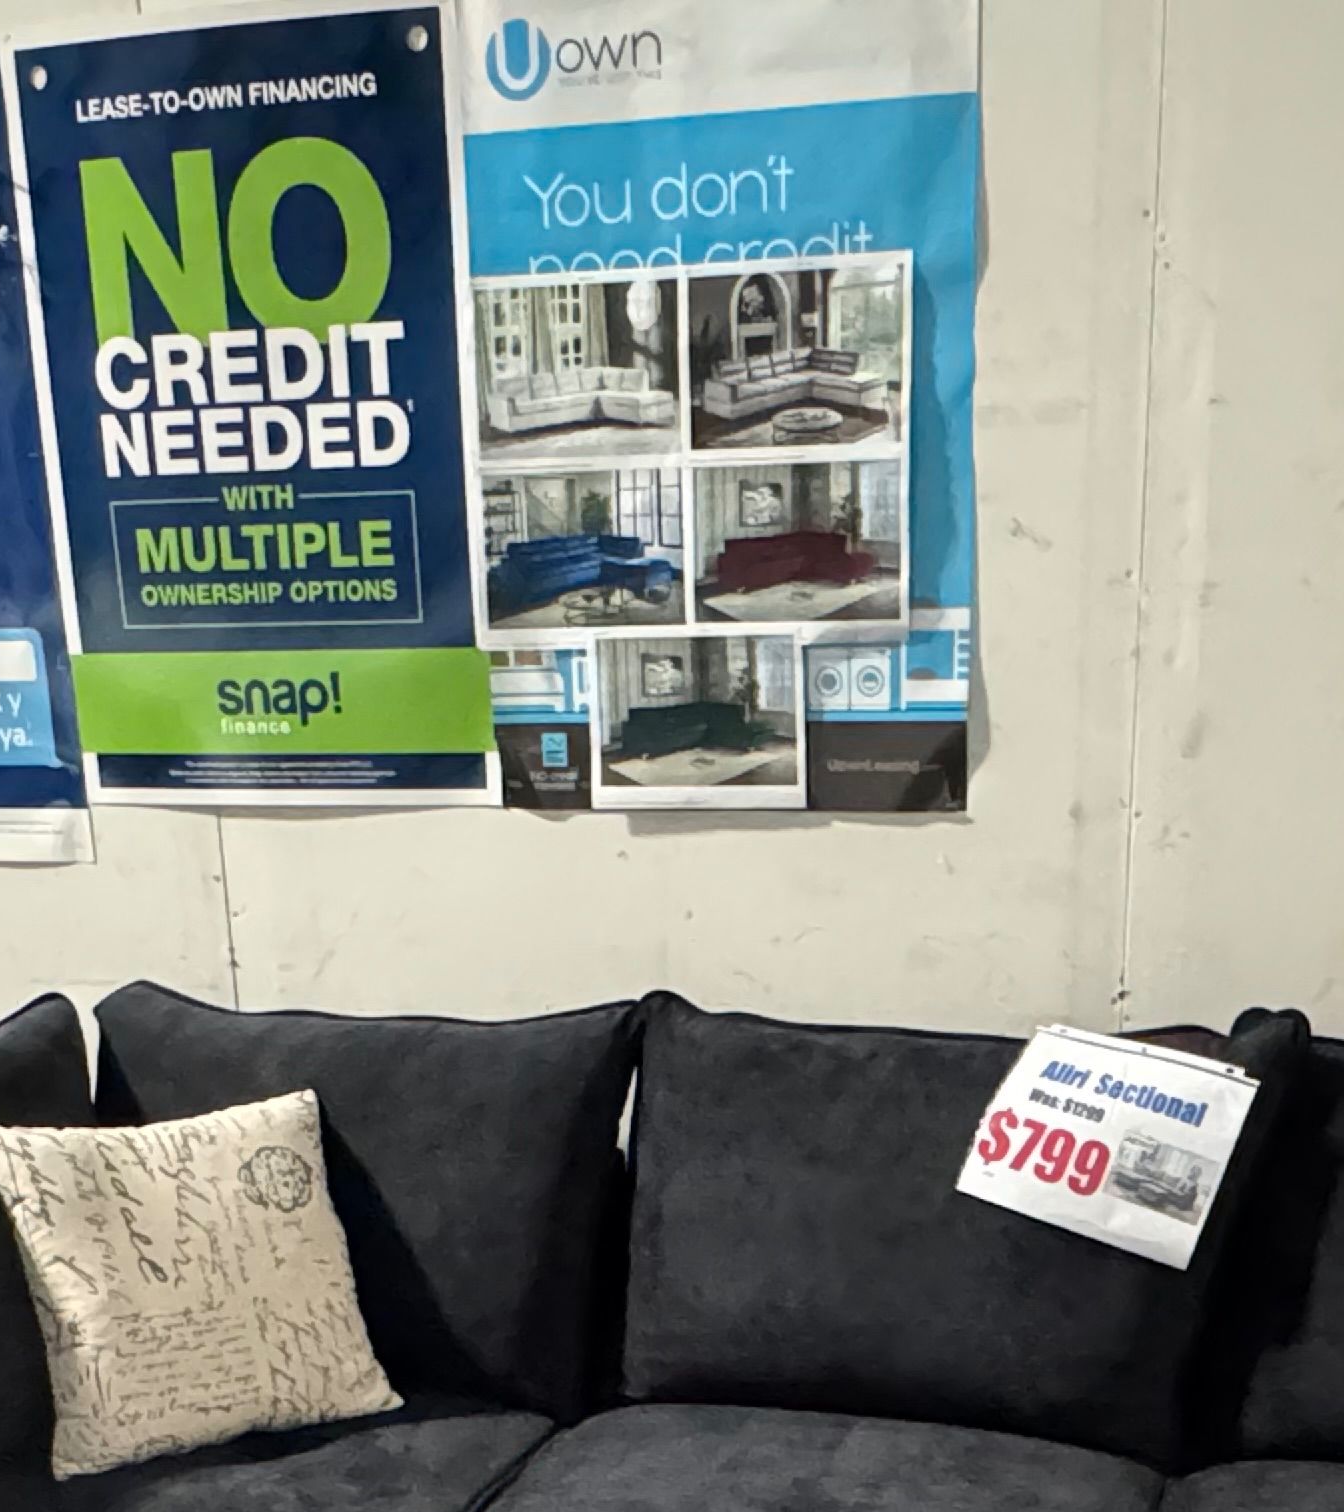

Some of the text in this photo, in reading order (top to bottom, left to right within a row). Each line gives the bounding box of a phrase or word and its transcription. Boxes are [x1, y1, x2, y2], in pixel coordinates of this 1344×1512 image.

[75, 72, 377, 123] LEASE-TO-OWN FINANCING
[522, 154, 795, 229] You don't
[79, 136, 392, 352] NO
[94, 321, 404, 410] CREDIT
[100, 400, 411, 478] NEEDED
[221, 483, 295, 512] WITH
[135, 519, 395, 574] MULTIPLE
[141, 578, 398, 607] OWNERSHIP OPTIONS
[7, 692, 22, 718] y
[217, 671, 342, 726] snap!
[220, 718, 291, 735] finance
[1094, 1072, 1209, 1128] Sectional
[978, 1107, 1112, 1196] $799
